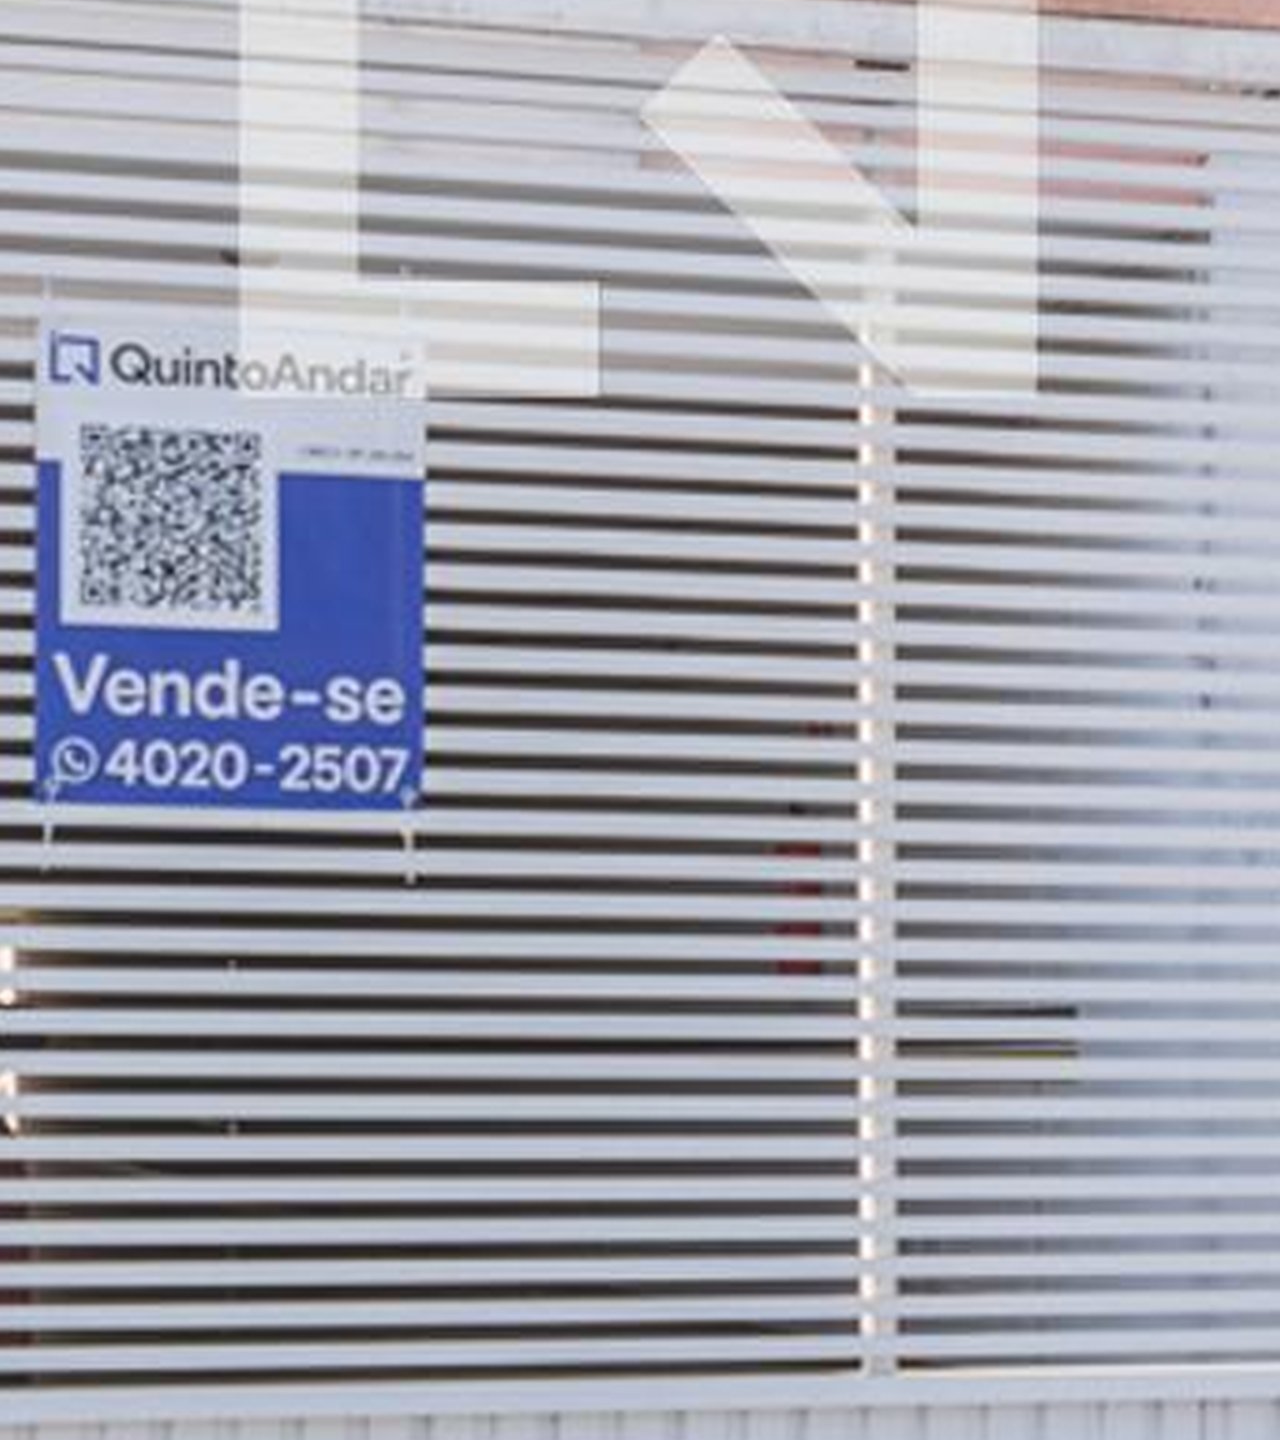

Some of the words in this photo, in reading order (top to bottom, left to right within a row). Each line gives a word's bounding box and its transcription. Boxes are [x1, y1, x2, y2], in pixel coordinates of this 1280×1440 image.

[109, 342, 413, 395] QuintoAndar
[52, 652, 406, 724] Vende-se
[104, 737, 411, 793] 4020-2507
